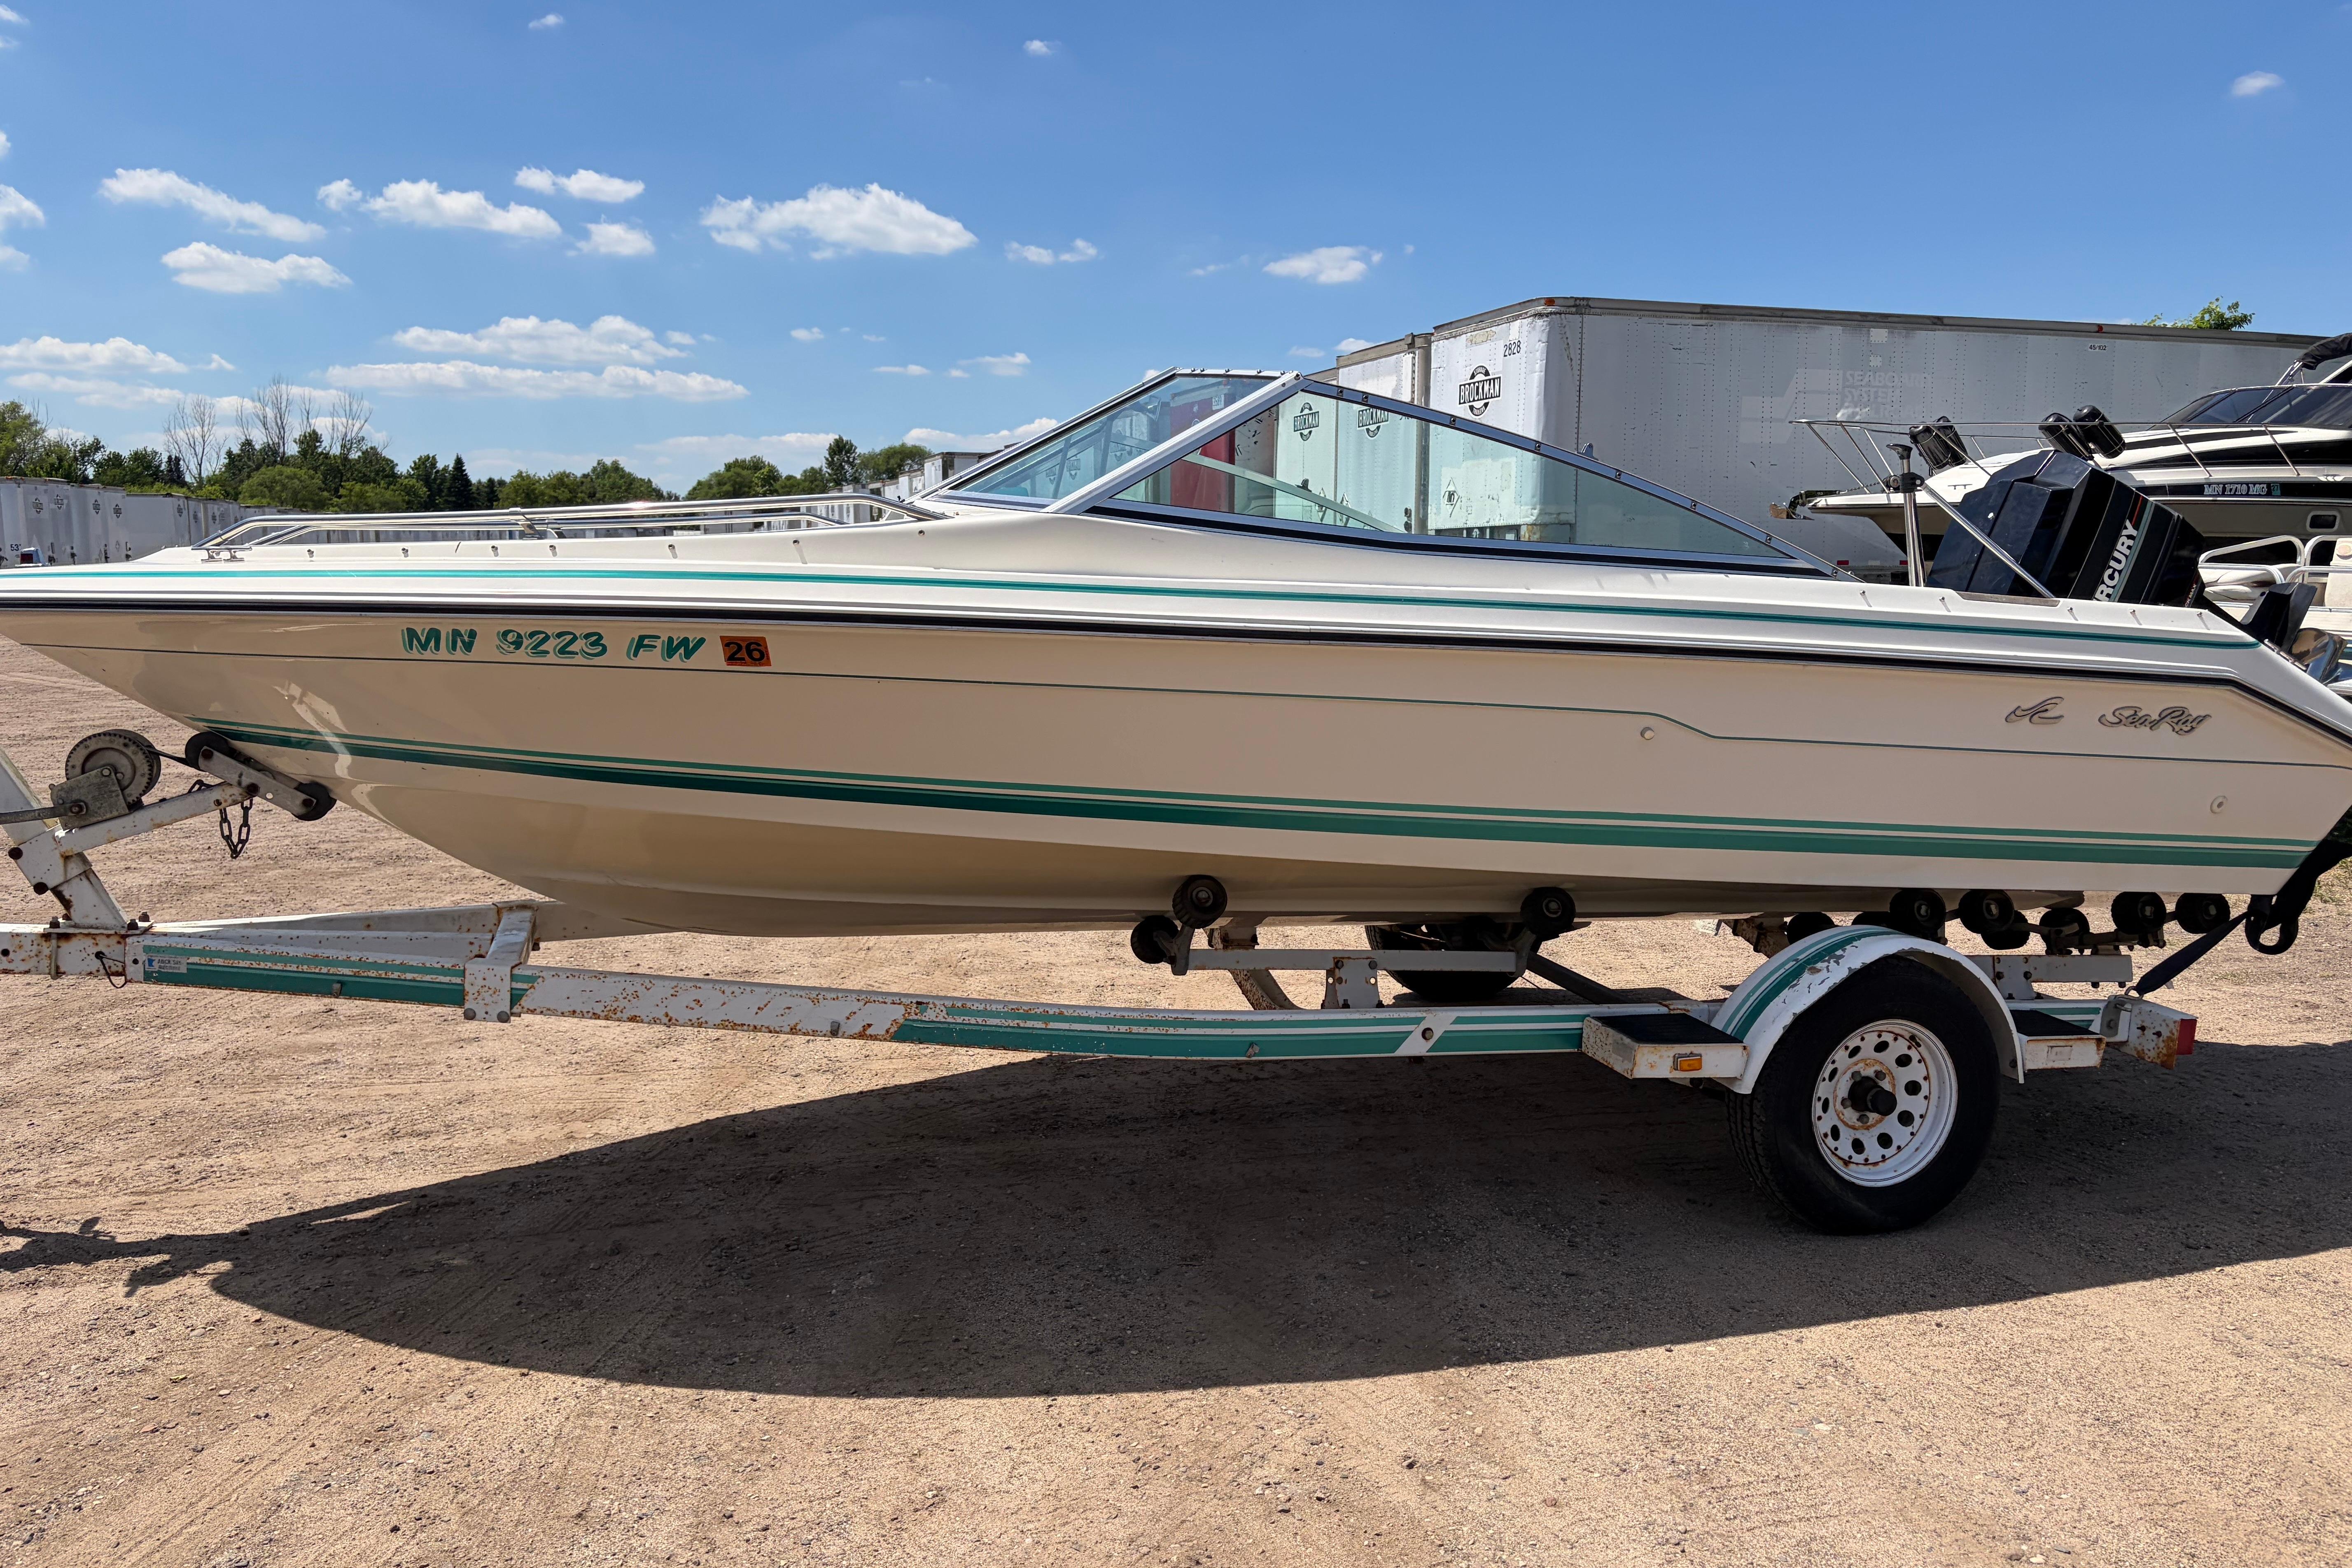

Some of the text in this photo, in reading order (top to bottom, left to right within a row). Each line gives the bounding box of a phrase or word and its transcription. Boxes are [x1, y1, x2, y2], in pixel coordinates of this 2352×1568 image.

[1503, 340, 1521, 357] 2828
[1460, 378, 1499, 404] BROCKMAN
[1295, 412, 1319, 431] BROCKMAN
[1359, 408, 1388, 427] BROCKMAN
[2204, 484, 2223, 495] MN
[2249, 484, 2268, 495] MG
[2093, 519, 2138, 602] RCURY
[401, 627, 706, 663] MN 9223 FW
[724, 641, 765, 662] 26
